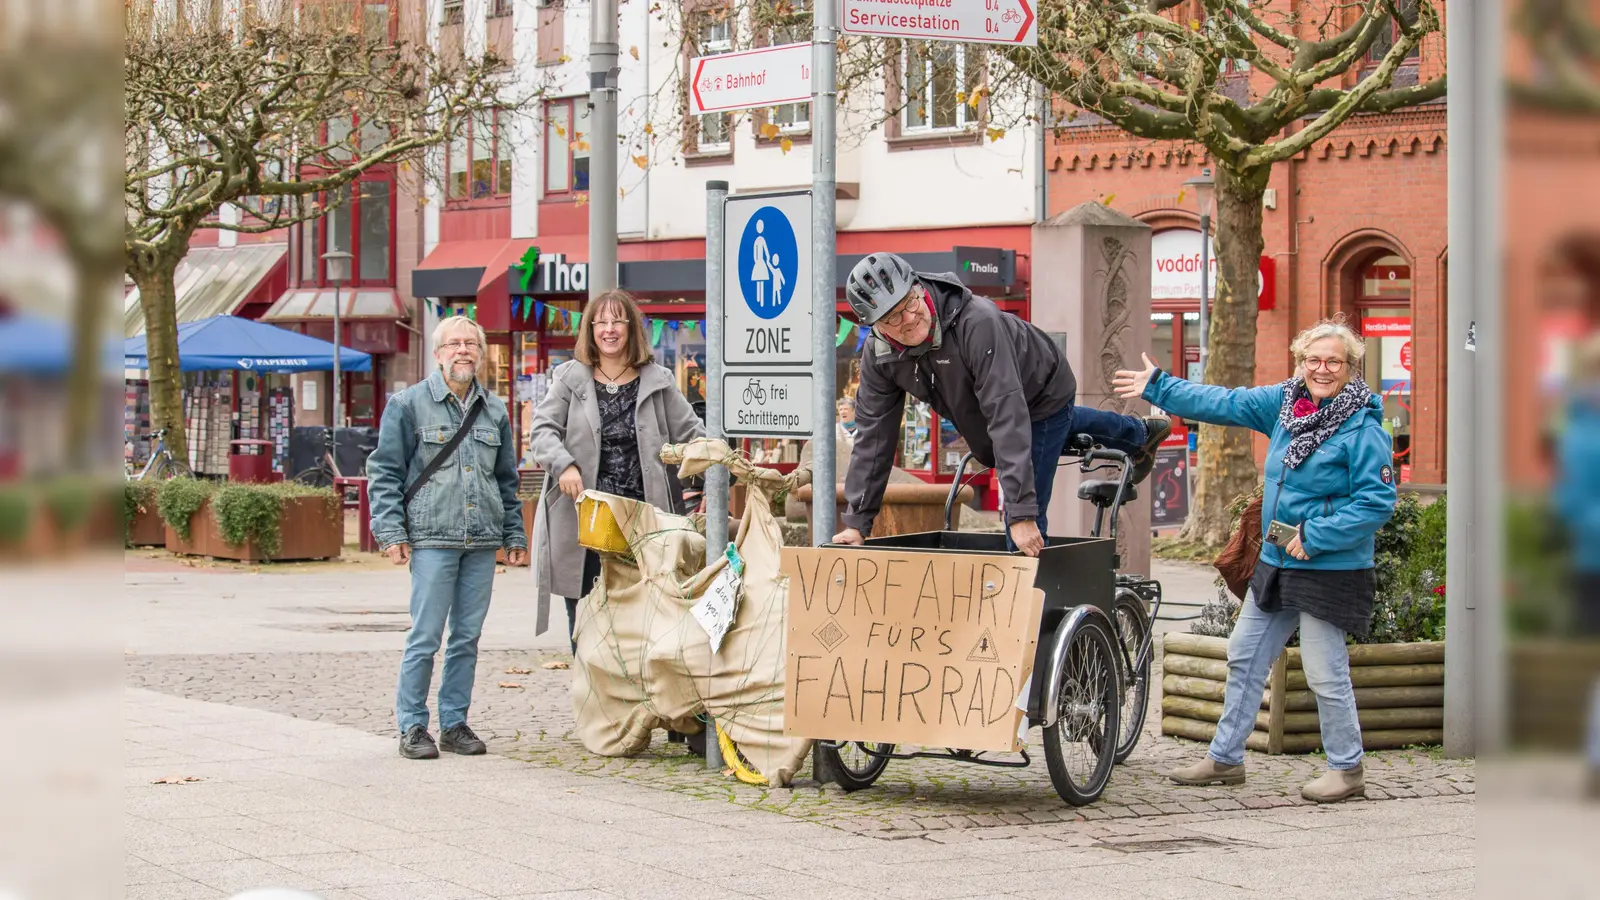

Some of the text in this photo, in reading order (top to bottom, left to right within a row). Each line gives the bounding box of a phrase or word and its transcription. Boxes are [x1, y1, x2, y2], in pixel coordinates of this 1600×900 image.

[850, 8, 960, 32] Servicestation
[726, 69, 767, 90] Bahnhof
[970, 261, 999, 273] Thalia
[746, 327, 791, 354] ZONE
[770, 384, 788, 400] frei
[737, 409, 800, 430] Schritttempo
[797, 554, 1032, 628] VORFAHRT
[867, 621, 953, 656] FÜR'S
[794, 655, 1015, 728] FAHRRAD
